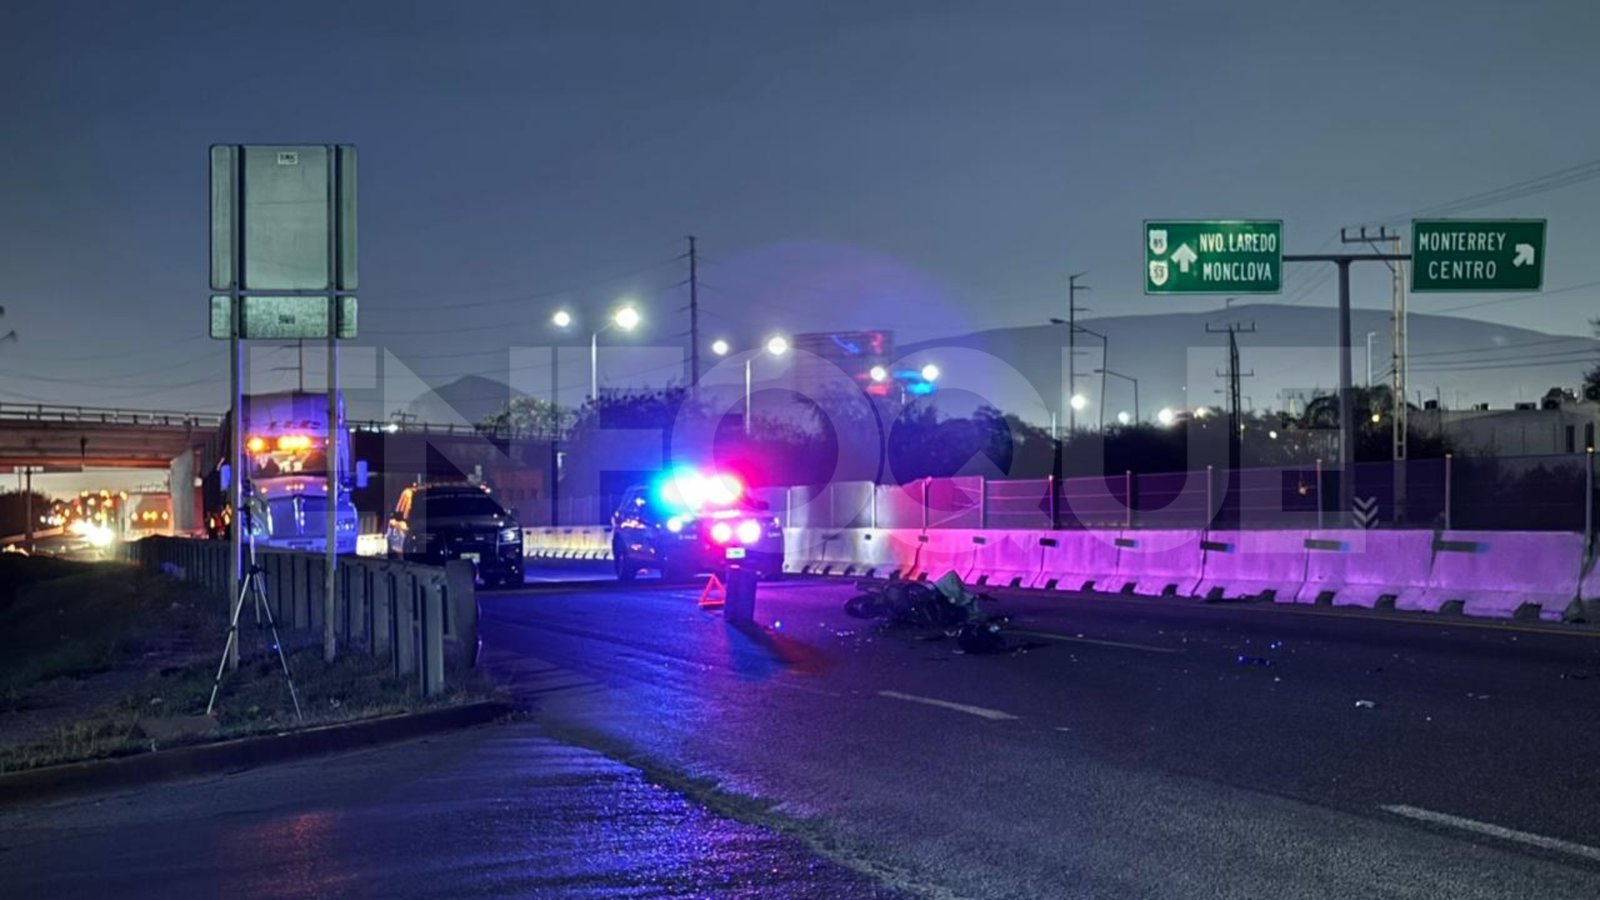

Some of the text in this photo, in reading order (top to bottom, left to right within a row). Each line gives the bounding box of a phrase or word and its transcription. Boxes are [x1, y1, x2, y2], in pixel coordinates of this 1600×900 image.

[1199, 233, 1276, 252] NVO. LAREDO
[1419, 232, 1506, 251] MONTERREY
[1203, 262, 1272, 280] MONCLOVA
[1428, 261, 1497, 279] CENTRO
